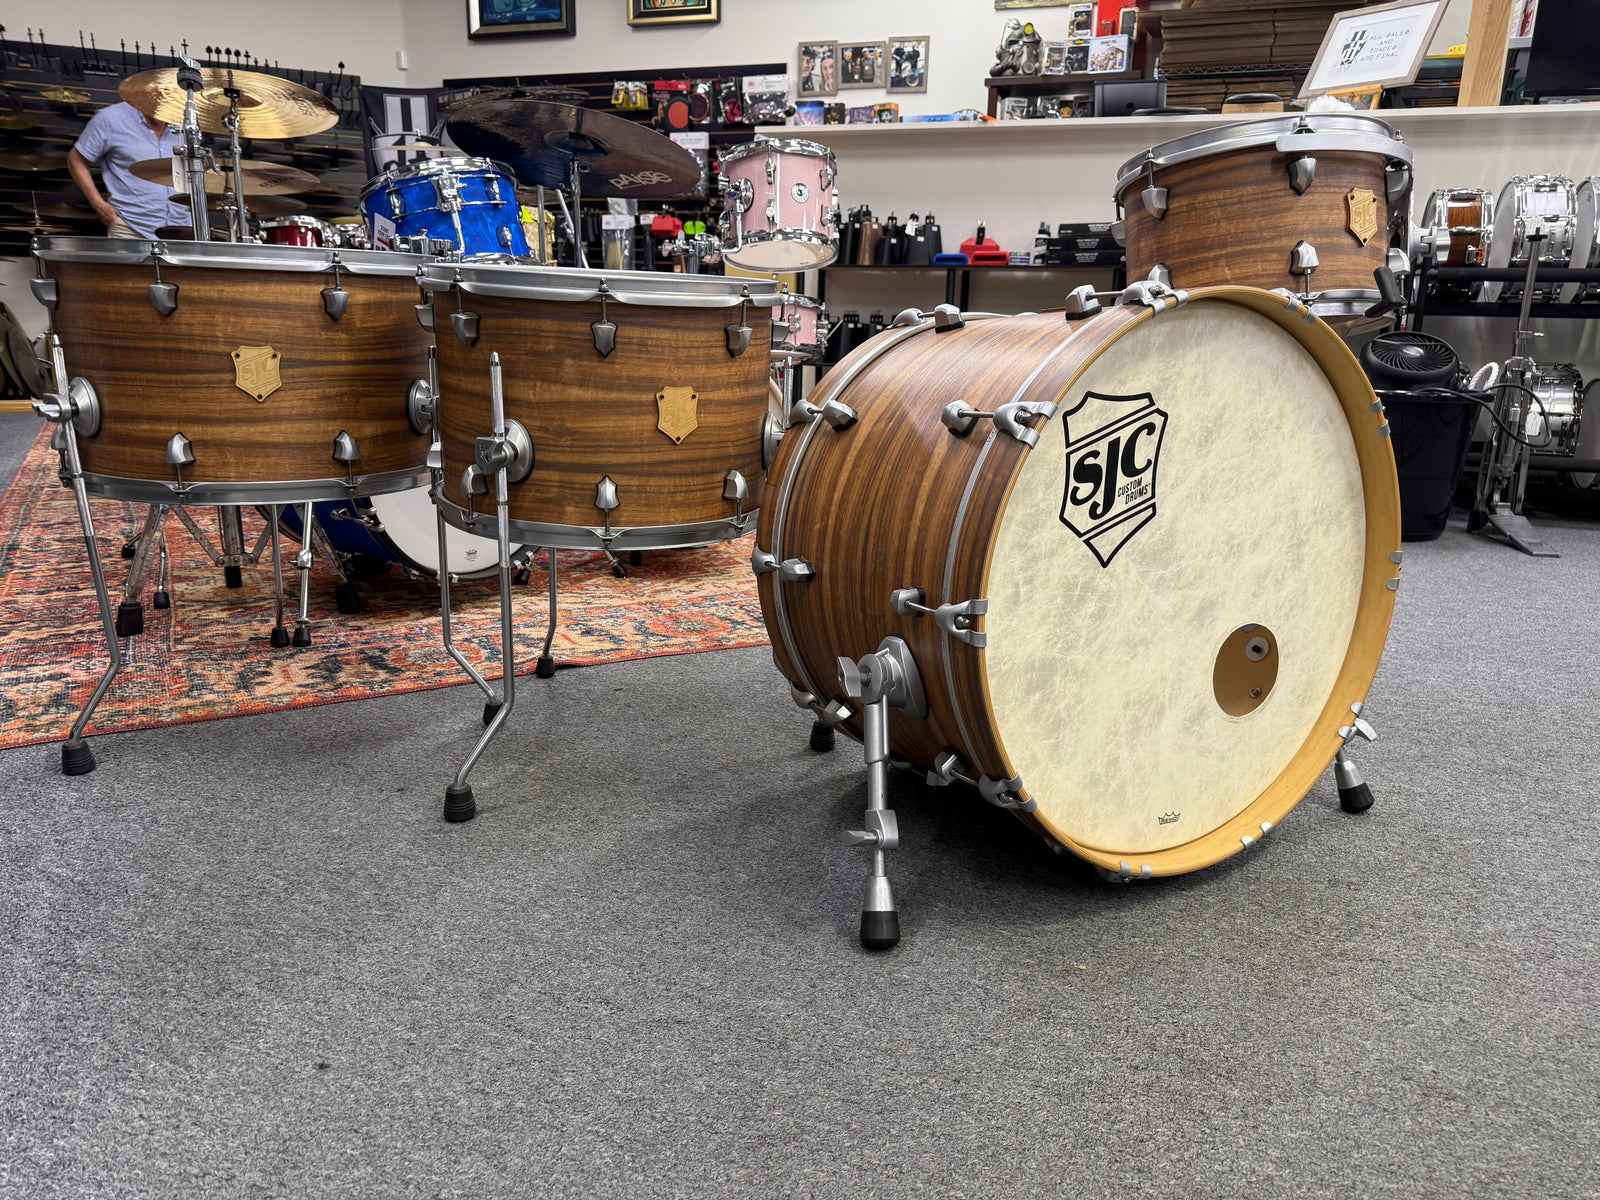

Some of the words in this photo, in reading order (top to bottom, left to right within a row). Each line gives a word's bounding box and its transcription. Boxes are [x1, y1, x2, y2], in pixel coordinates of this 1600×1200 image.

[1069, 421, 1157, 521] SJC
[1117, 476, 1143, 497] CUSTOM
[1124, 484, 1149, 505] DRUMS
